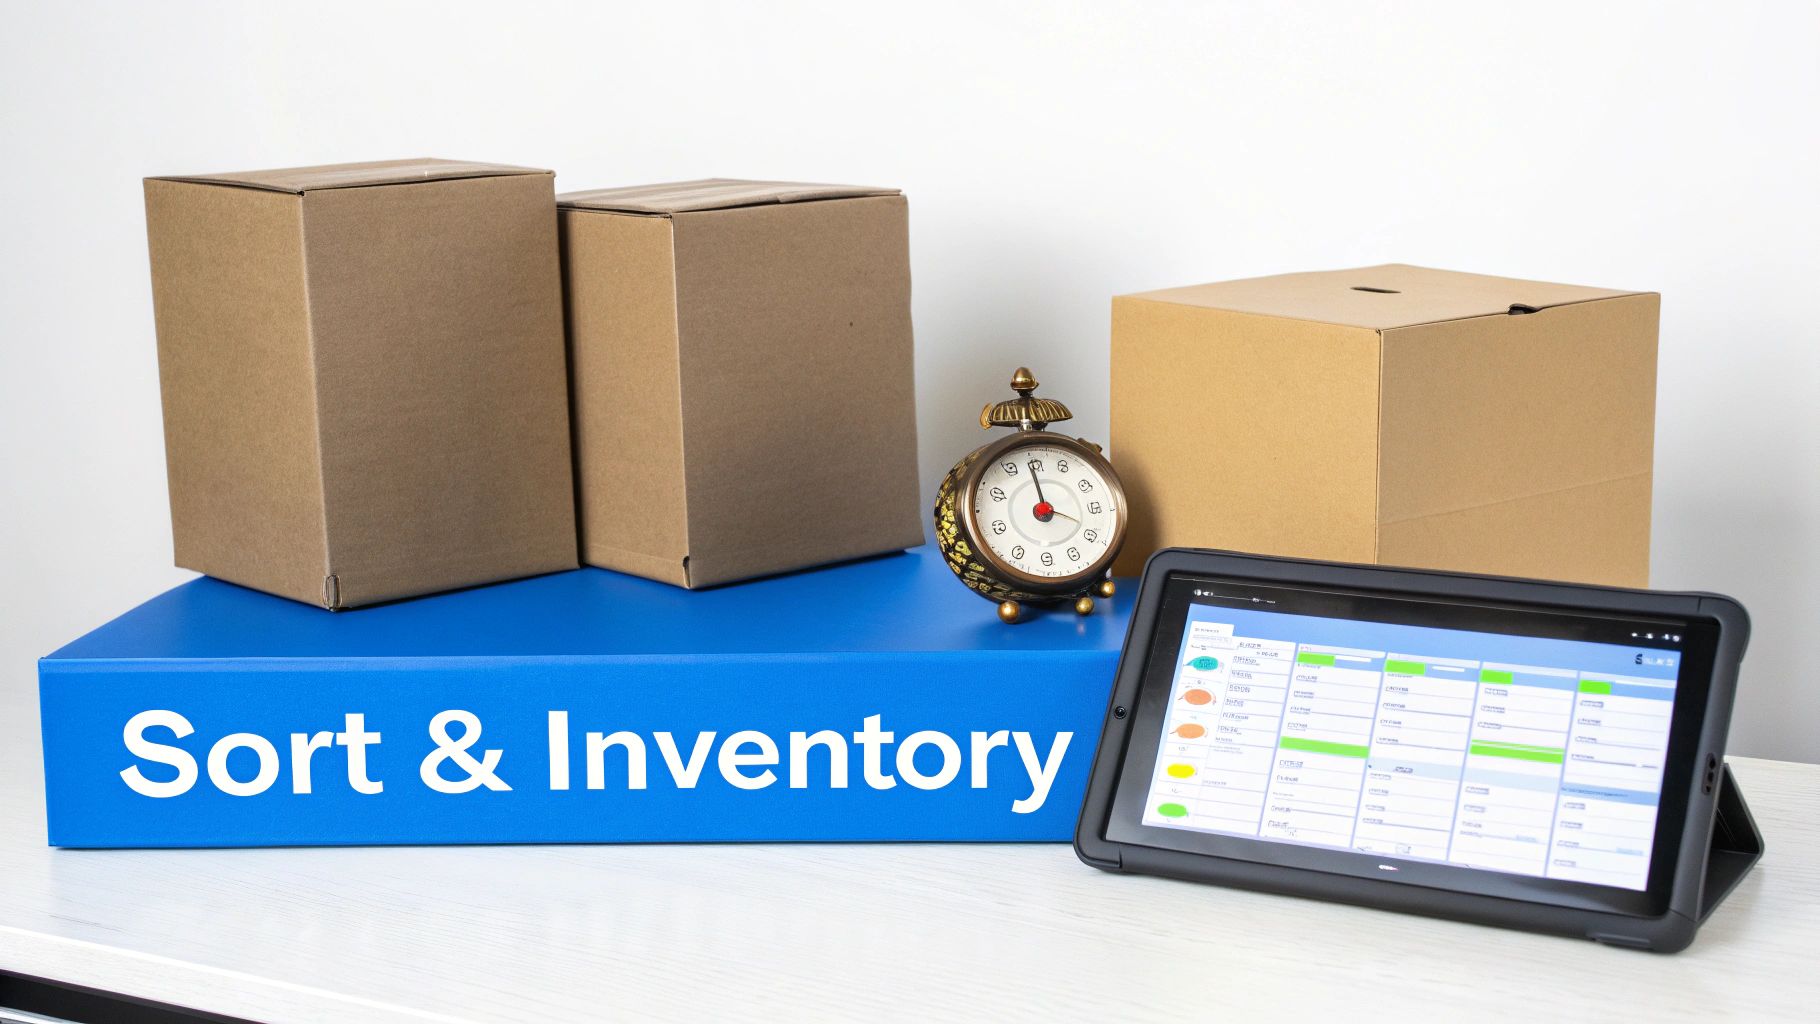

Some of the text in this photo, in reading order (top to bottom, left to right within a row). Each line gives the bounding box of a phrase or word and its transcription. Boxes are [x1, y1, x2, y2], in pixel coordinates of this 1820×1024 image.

[120, 710, 1073, 813] Sort & Inventory
